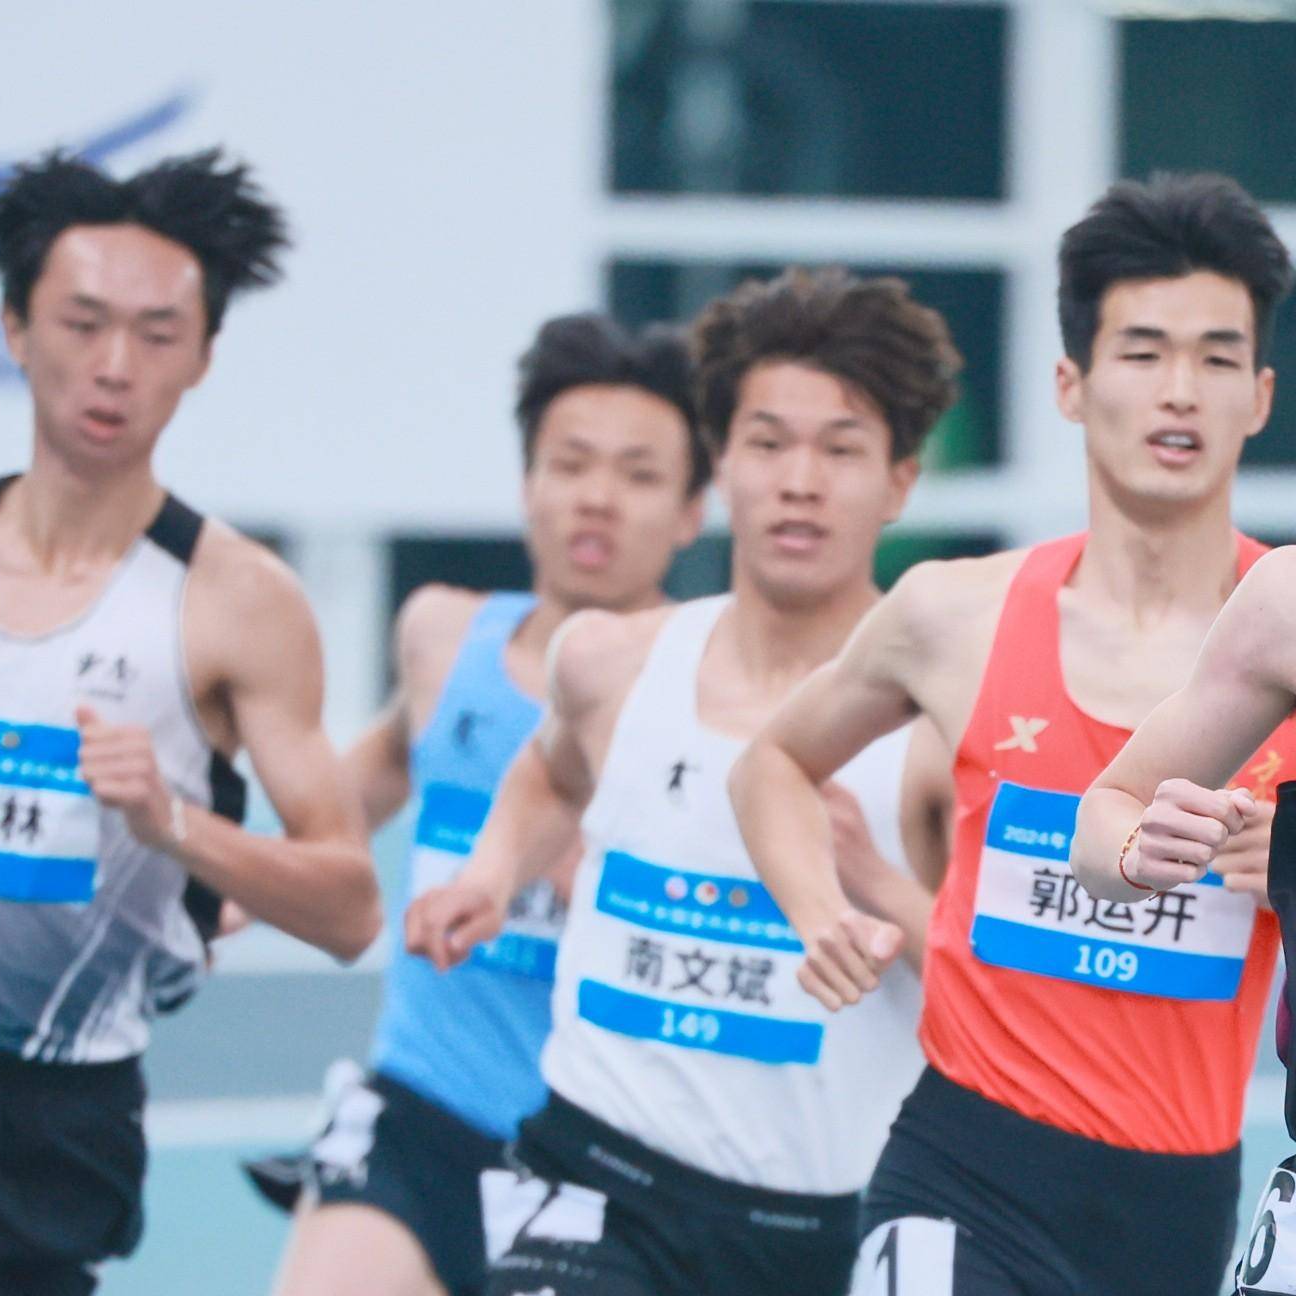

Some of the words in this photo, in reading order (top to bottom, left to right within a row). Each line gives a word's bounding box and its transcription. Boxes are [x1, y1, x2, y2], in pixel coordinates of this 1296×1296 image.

[1073, 945, 1139, 981] 109
[660, 1008, 721, 1042] 149
[1242, 1171, 1295, 1286] 6
